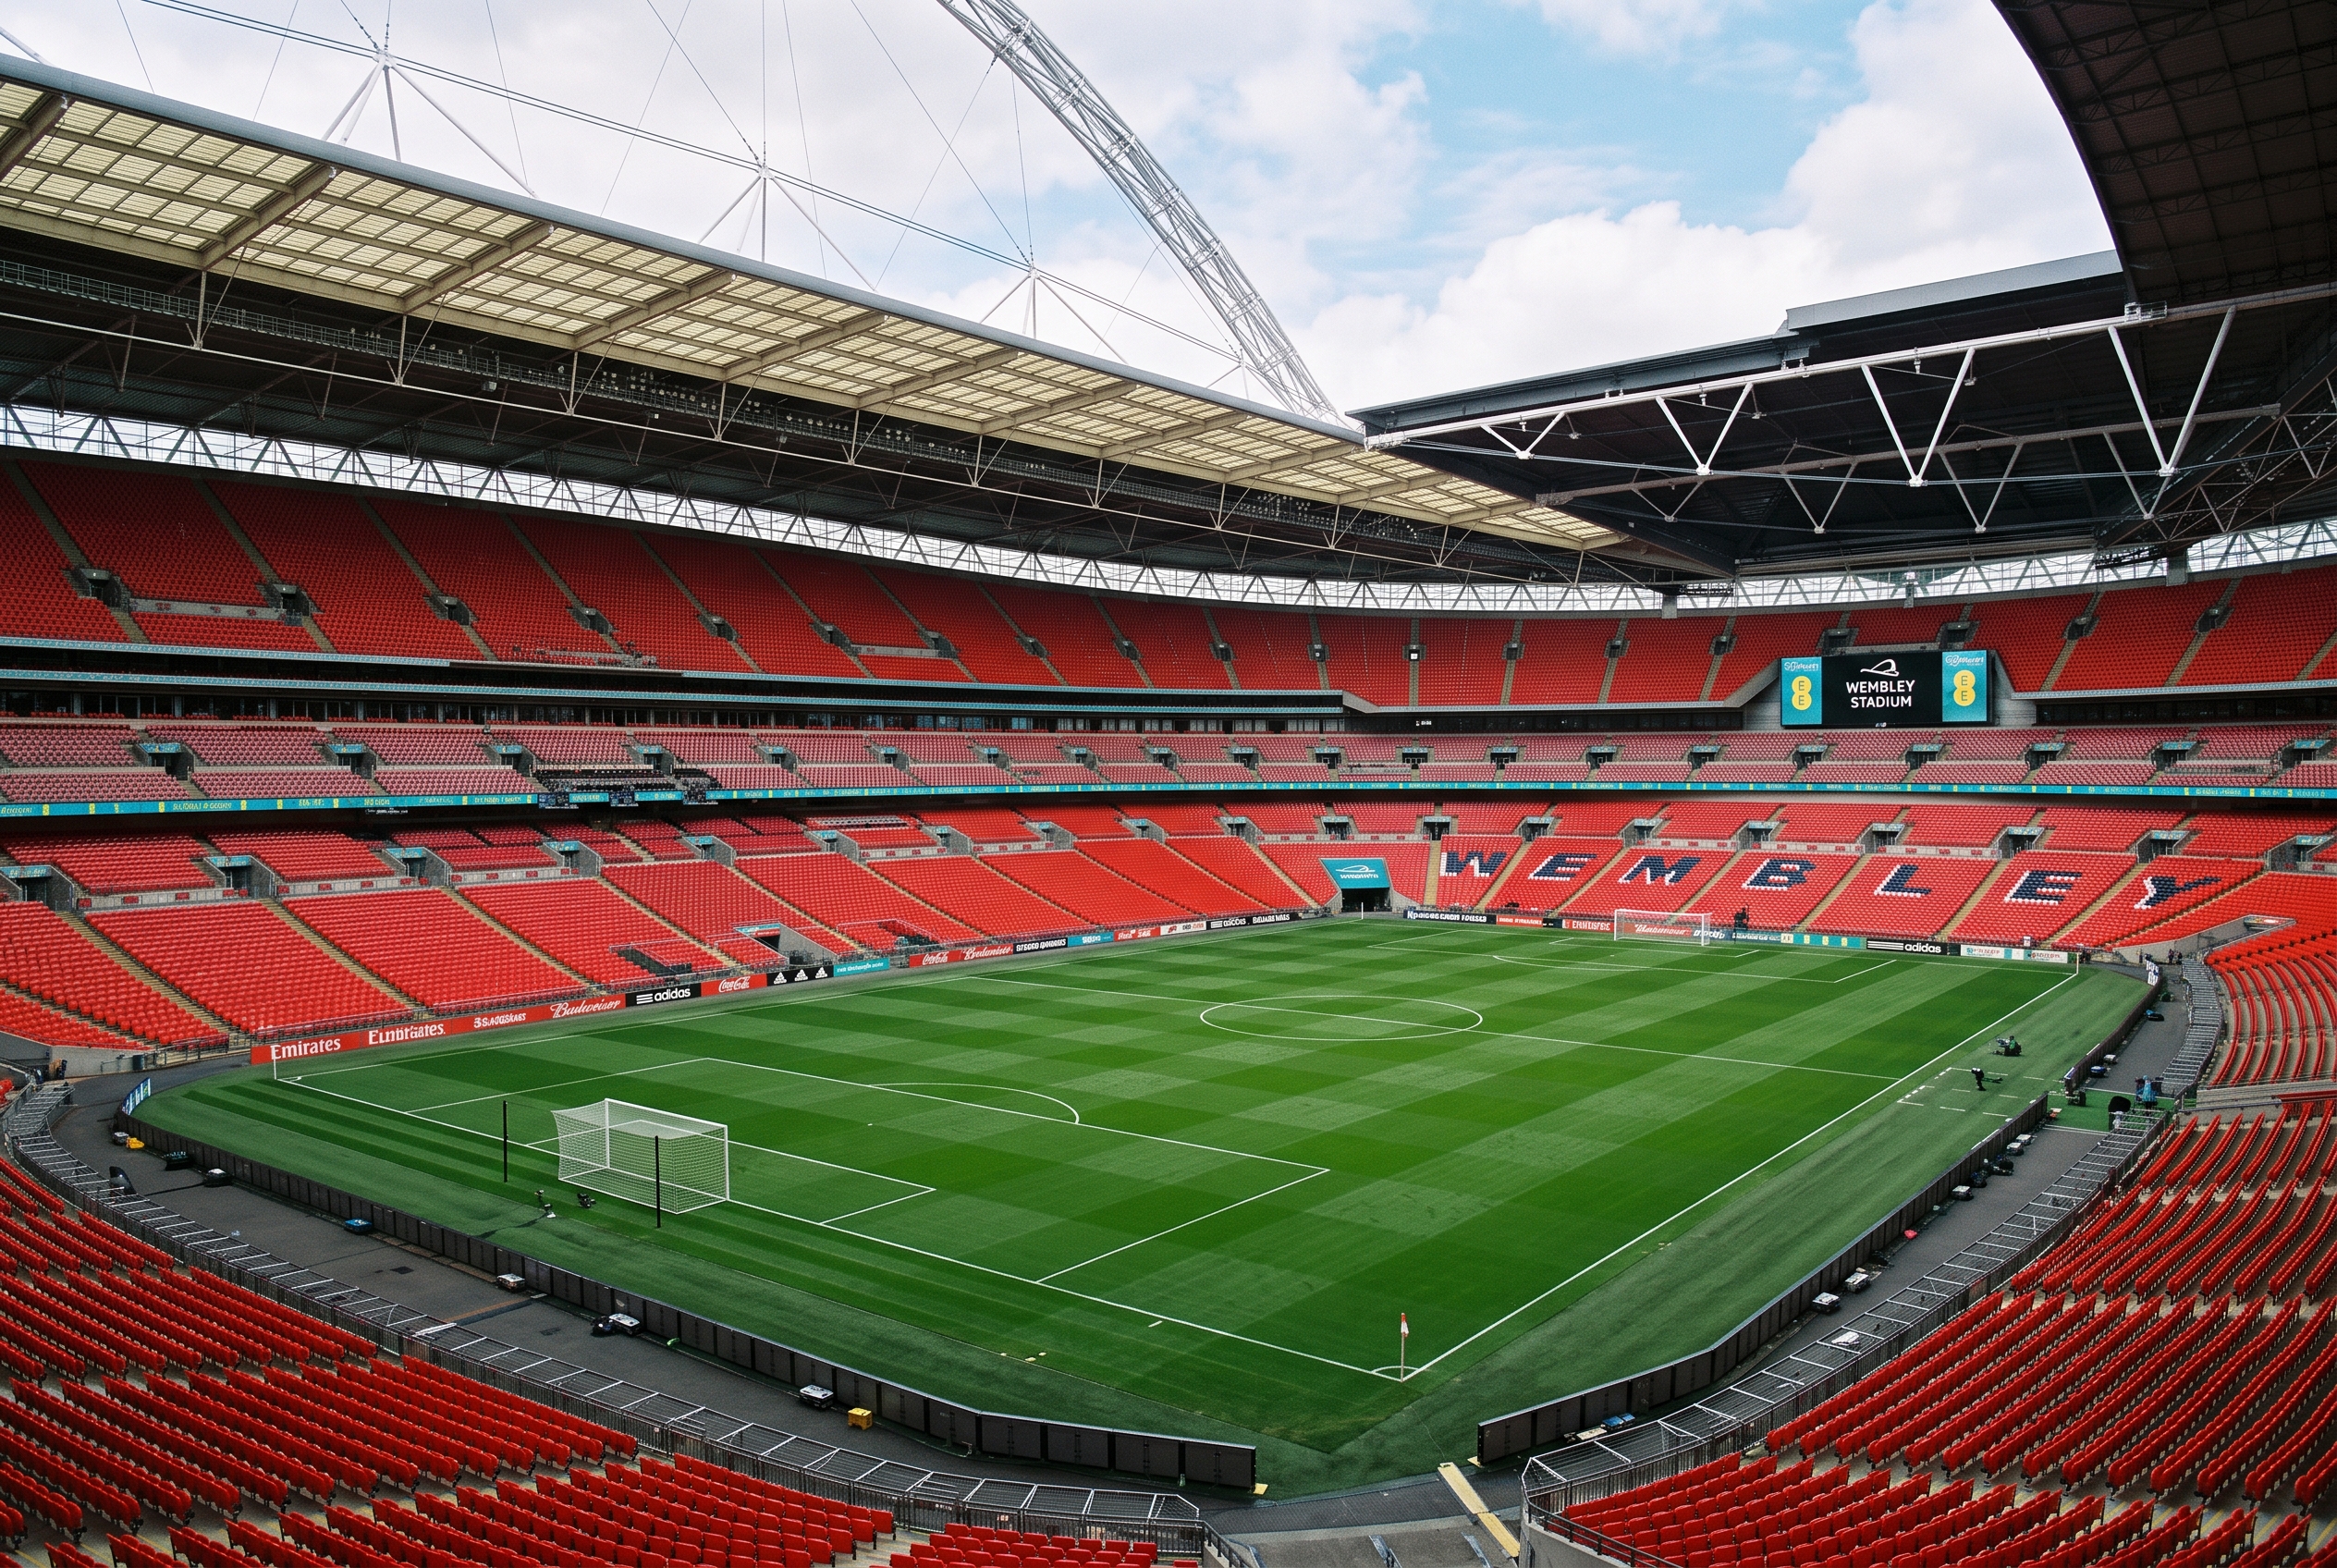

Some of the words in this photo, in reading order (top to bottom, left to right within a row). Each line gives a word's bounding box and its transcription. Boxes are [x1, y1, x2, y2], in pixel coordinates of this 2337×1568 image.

[1845, 680, 1915, 694] WEMBLEY
[1850, 695, 1912, 708] STADIUM
[1904, 942, 1941, 954] adidas
[654, 987, 691, 1001] adidas
[270, 1037, 341, 1060] Emirates
